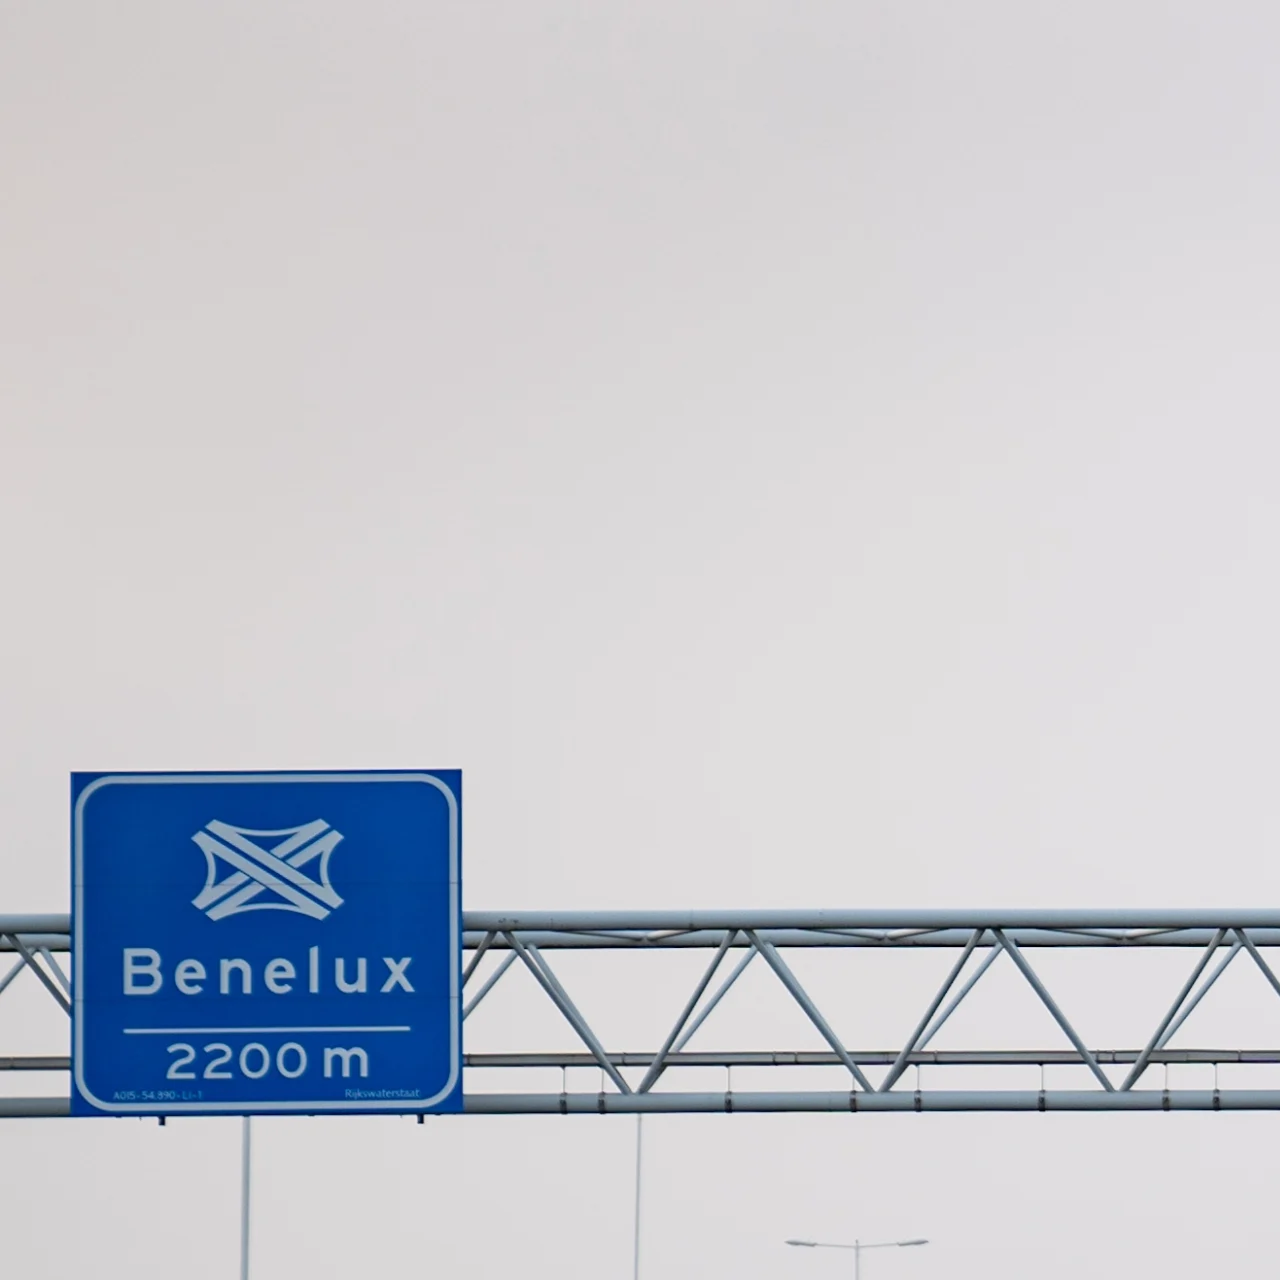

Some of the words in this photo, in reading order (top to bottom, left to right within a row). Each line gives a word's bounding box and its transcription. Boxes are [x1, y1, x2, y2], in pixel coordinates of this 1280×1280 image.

[123, 946, 415, 995] Benelux
[166, 1042, 307, 1079] 2200
[324, 1046, 368, 1078] m
[344, 1087, 421, 1099] Rijkswaterstaat
